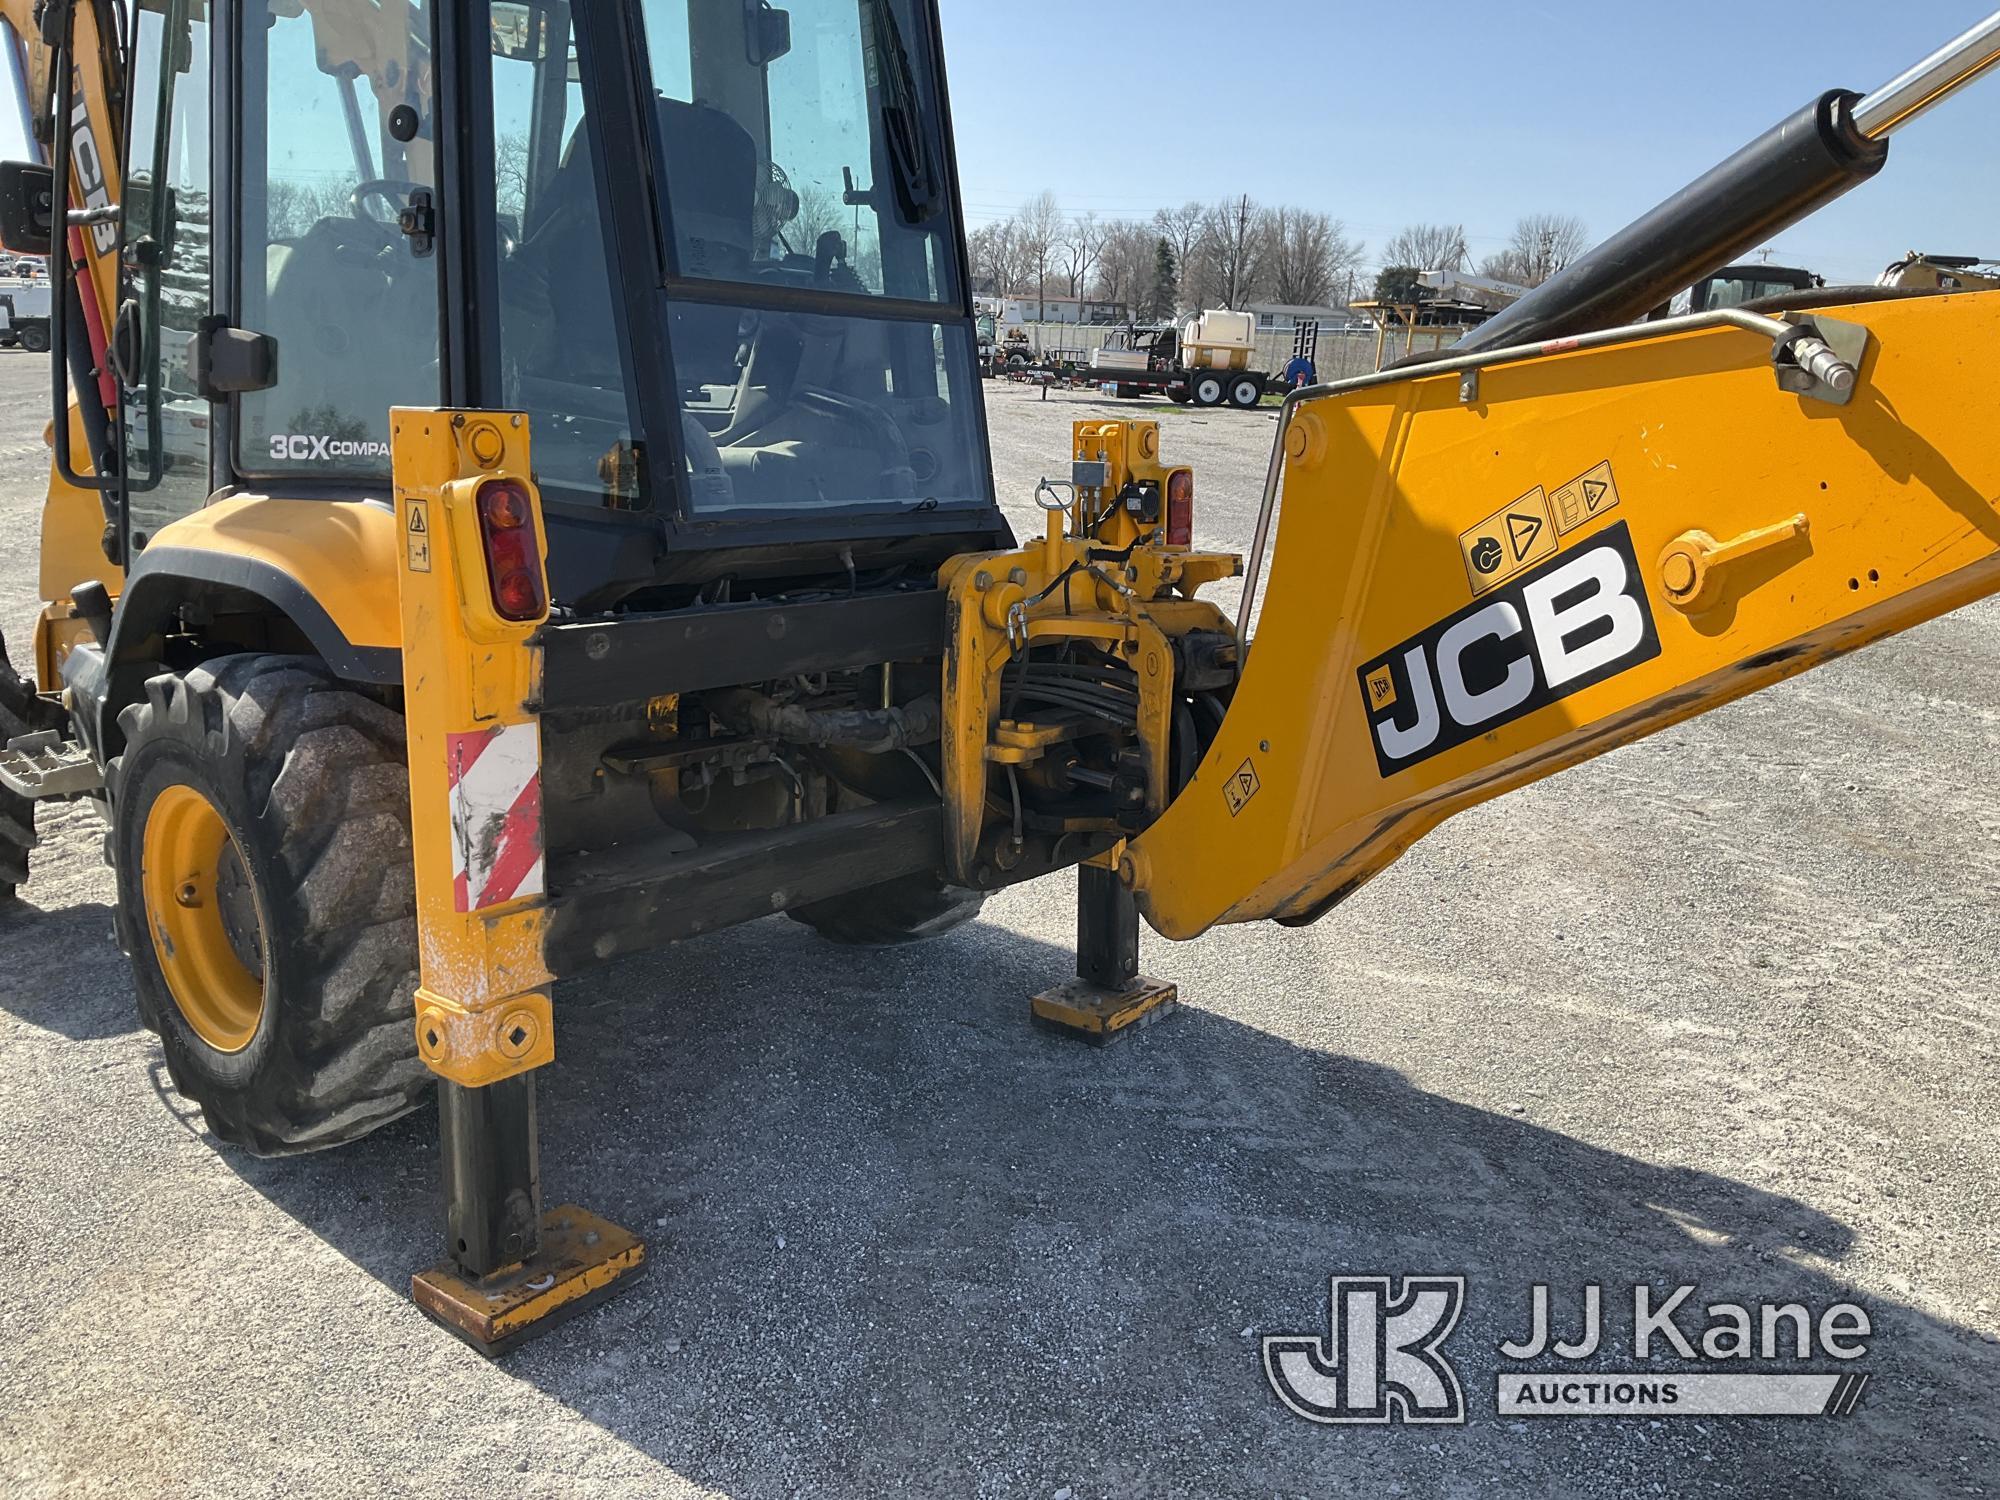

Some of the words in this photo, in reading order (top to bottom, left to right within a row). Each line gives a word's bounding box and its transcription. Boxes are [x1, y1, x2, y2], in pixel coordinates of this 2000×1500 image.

[1941, 276, 1954, 288] CAT
[270, 434, 330, 460] 3CX
[329, 441, 392, 456] COMPA
[1376, 546, 1644, 760] JCB
[1373, 679, 1390, 699] JCB
